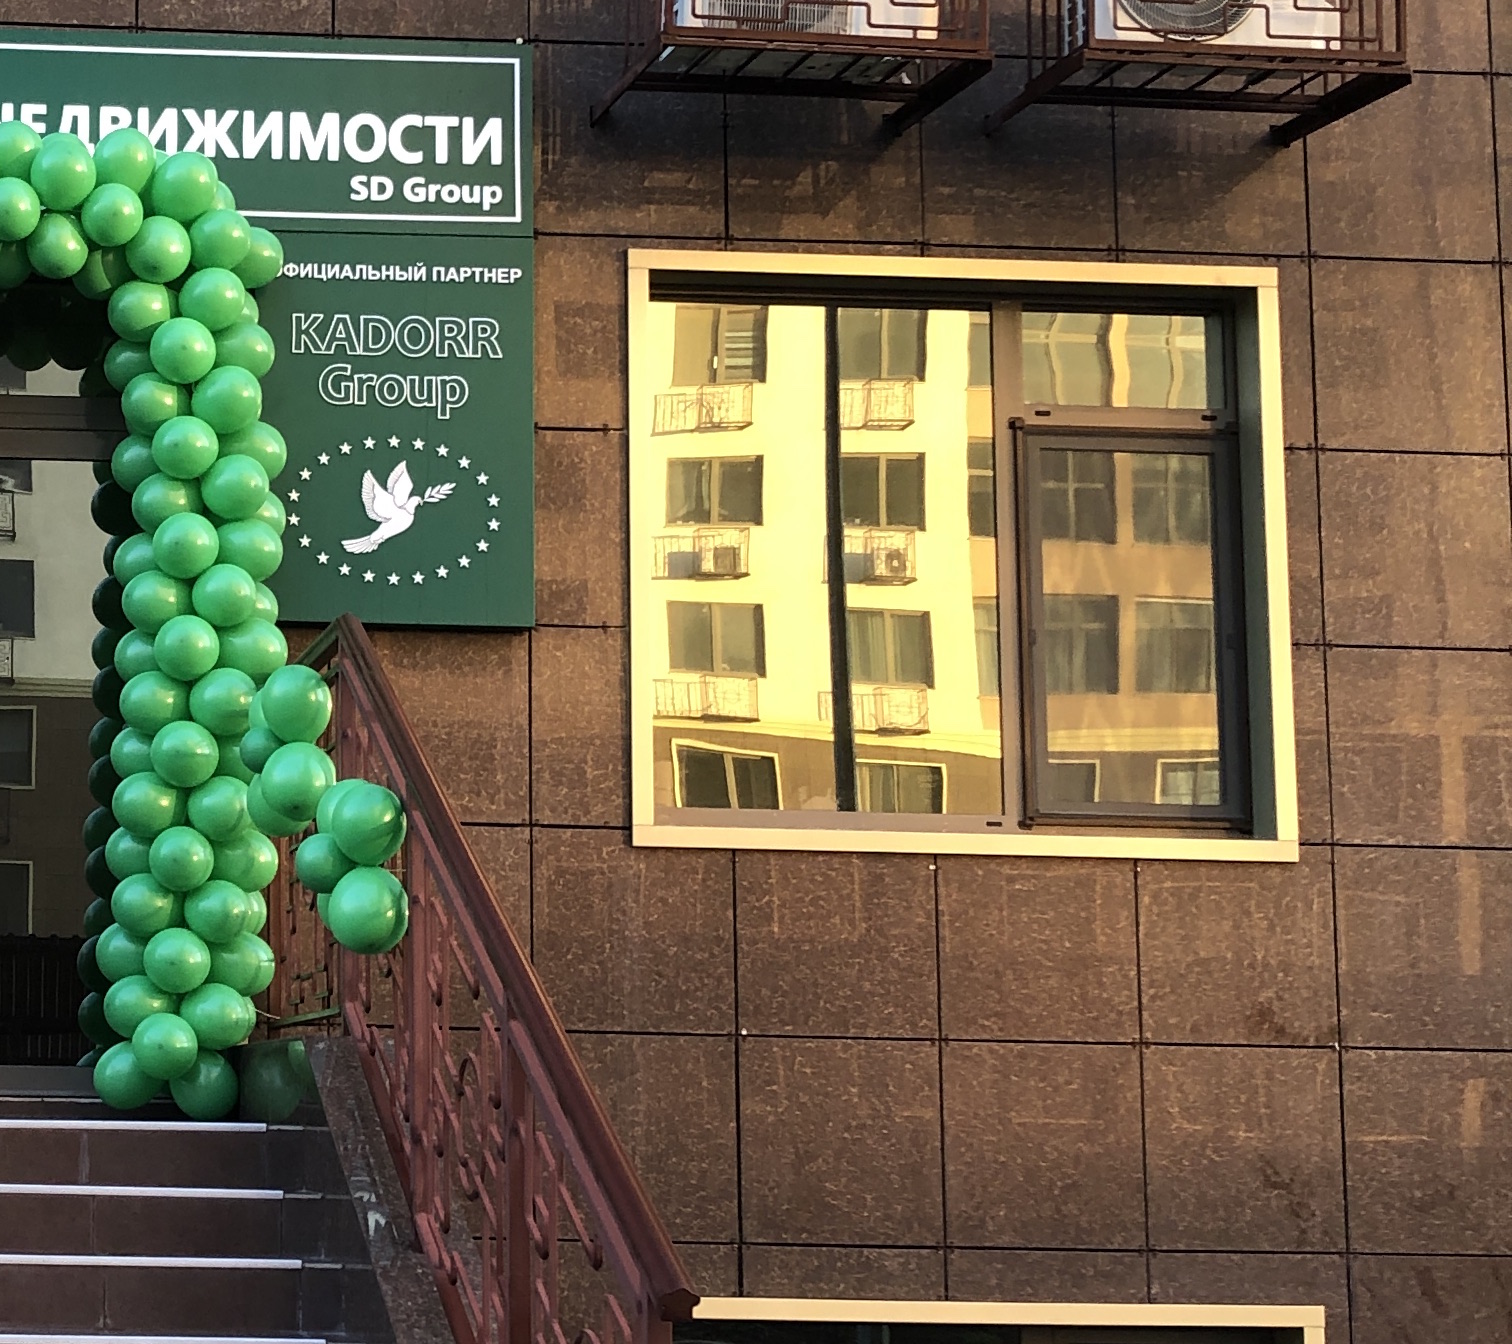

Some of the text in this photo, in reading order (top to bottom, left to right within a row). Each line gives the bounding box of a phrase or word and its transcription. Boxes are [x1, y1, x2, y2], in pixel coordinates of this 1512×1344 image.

[349, 174, 503, 211] SD Group
[432, 266, 523, 284] ПАРТНЕР
[291, 313, 504, 359] KADORR
[318, 363, 470, 420] Group
